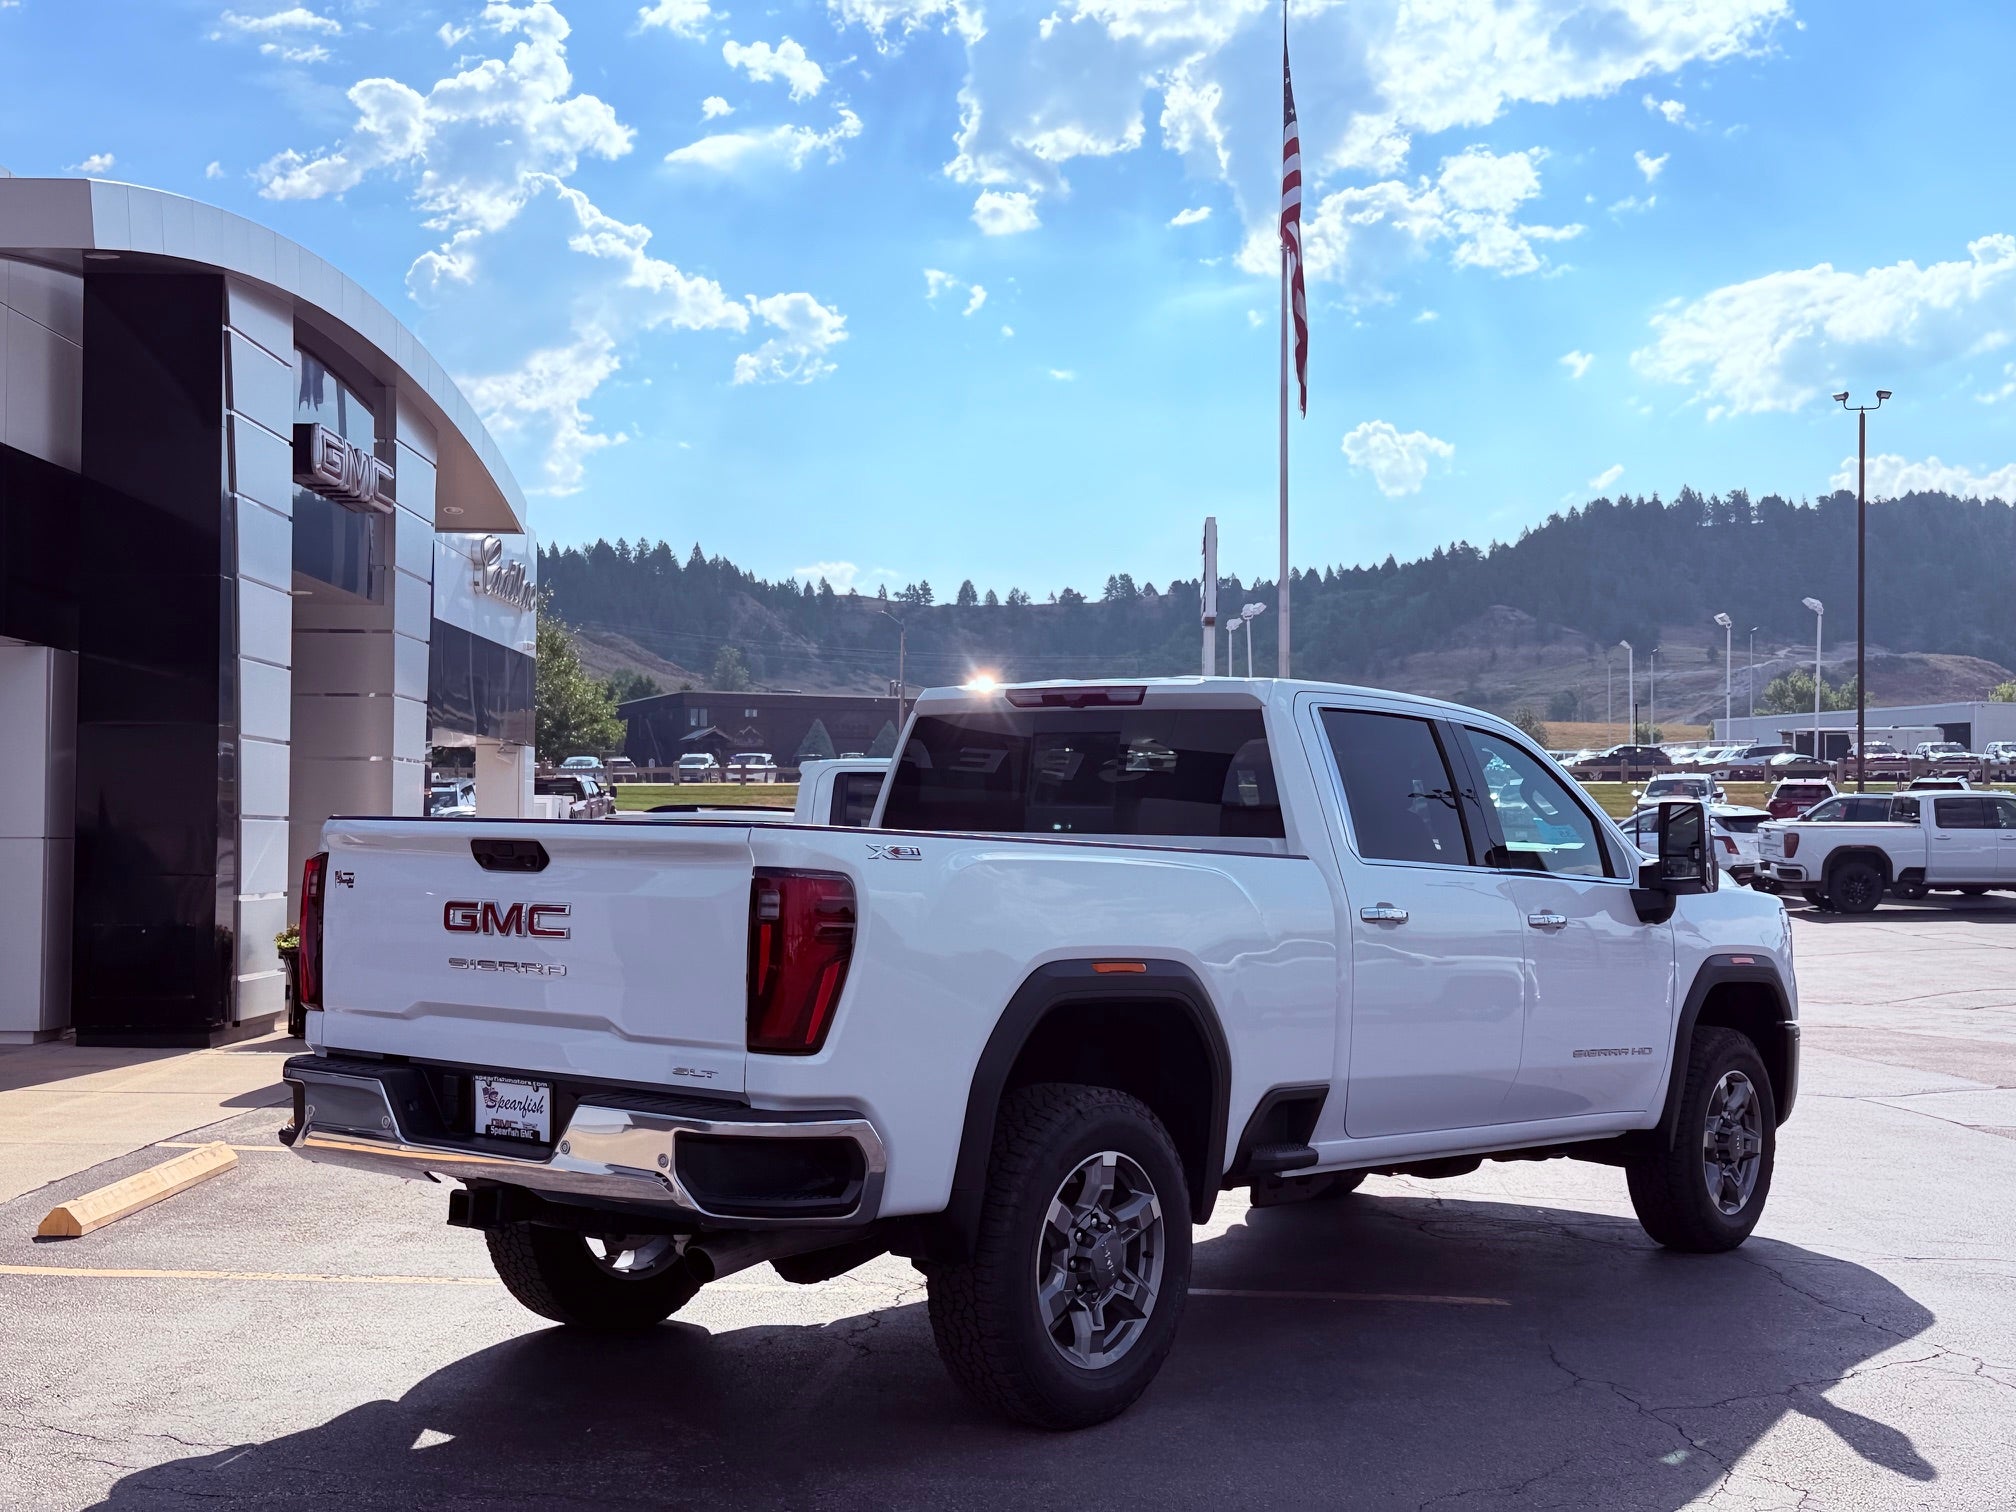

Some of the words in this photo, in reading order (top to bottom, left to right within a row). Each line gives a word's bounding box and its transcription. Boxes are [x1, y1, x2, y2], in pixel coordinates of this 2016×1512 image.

[311, 422, 394, 515] GMC
[480, 534, 537, 612] Cadillac
[865, 844, 922, 861] X31
[443, 899, 571, 940] GMC
[448, 957, 567, 977] SIERRA
[1572, 1048, 1630, 1058] SIERRA
[1631, 1047, 1653, 1056] HD
[672, 1067, 719, 1079] SLT
[486, 1091, 545, 1118] Spearfish
[490, 1126, 519, 1137] Spearfish
